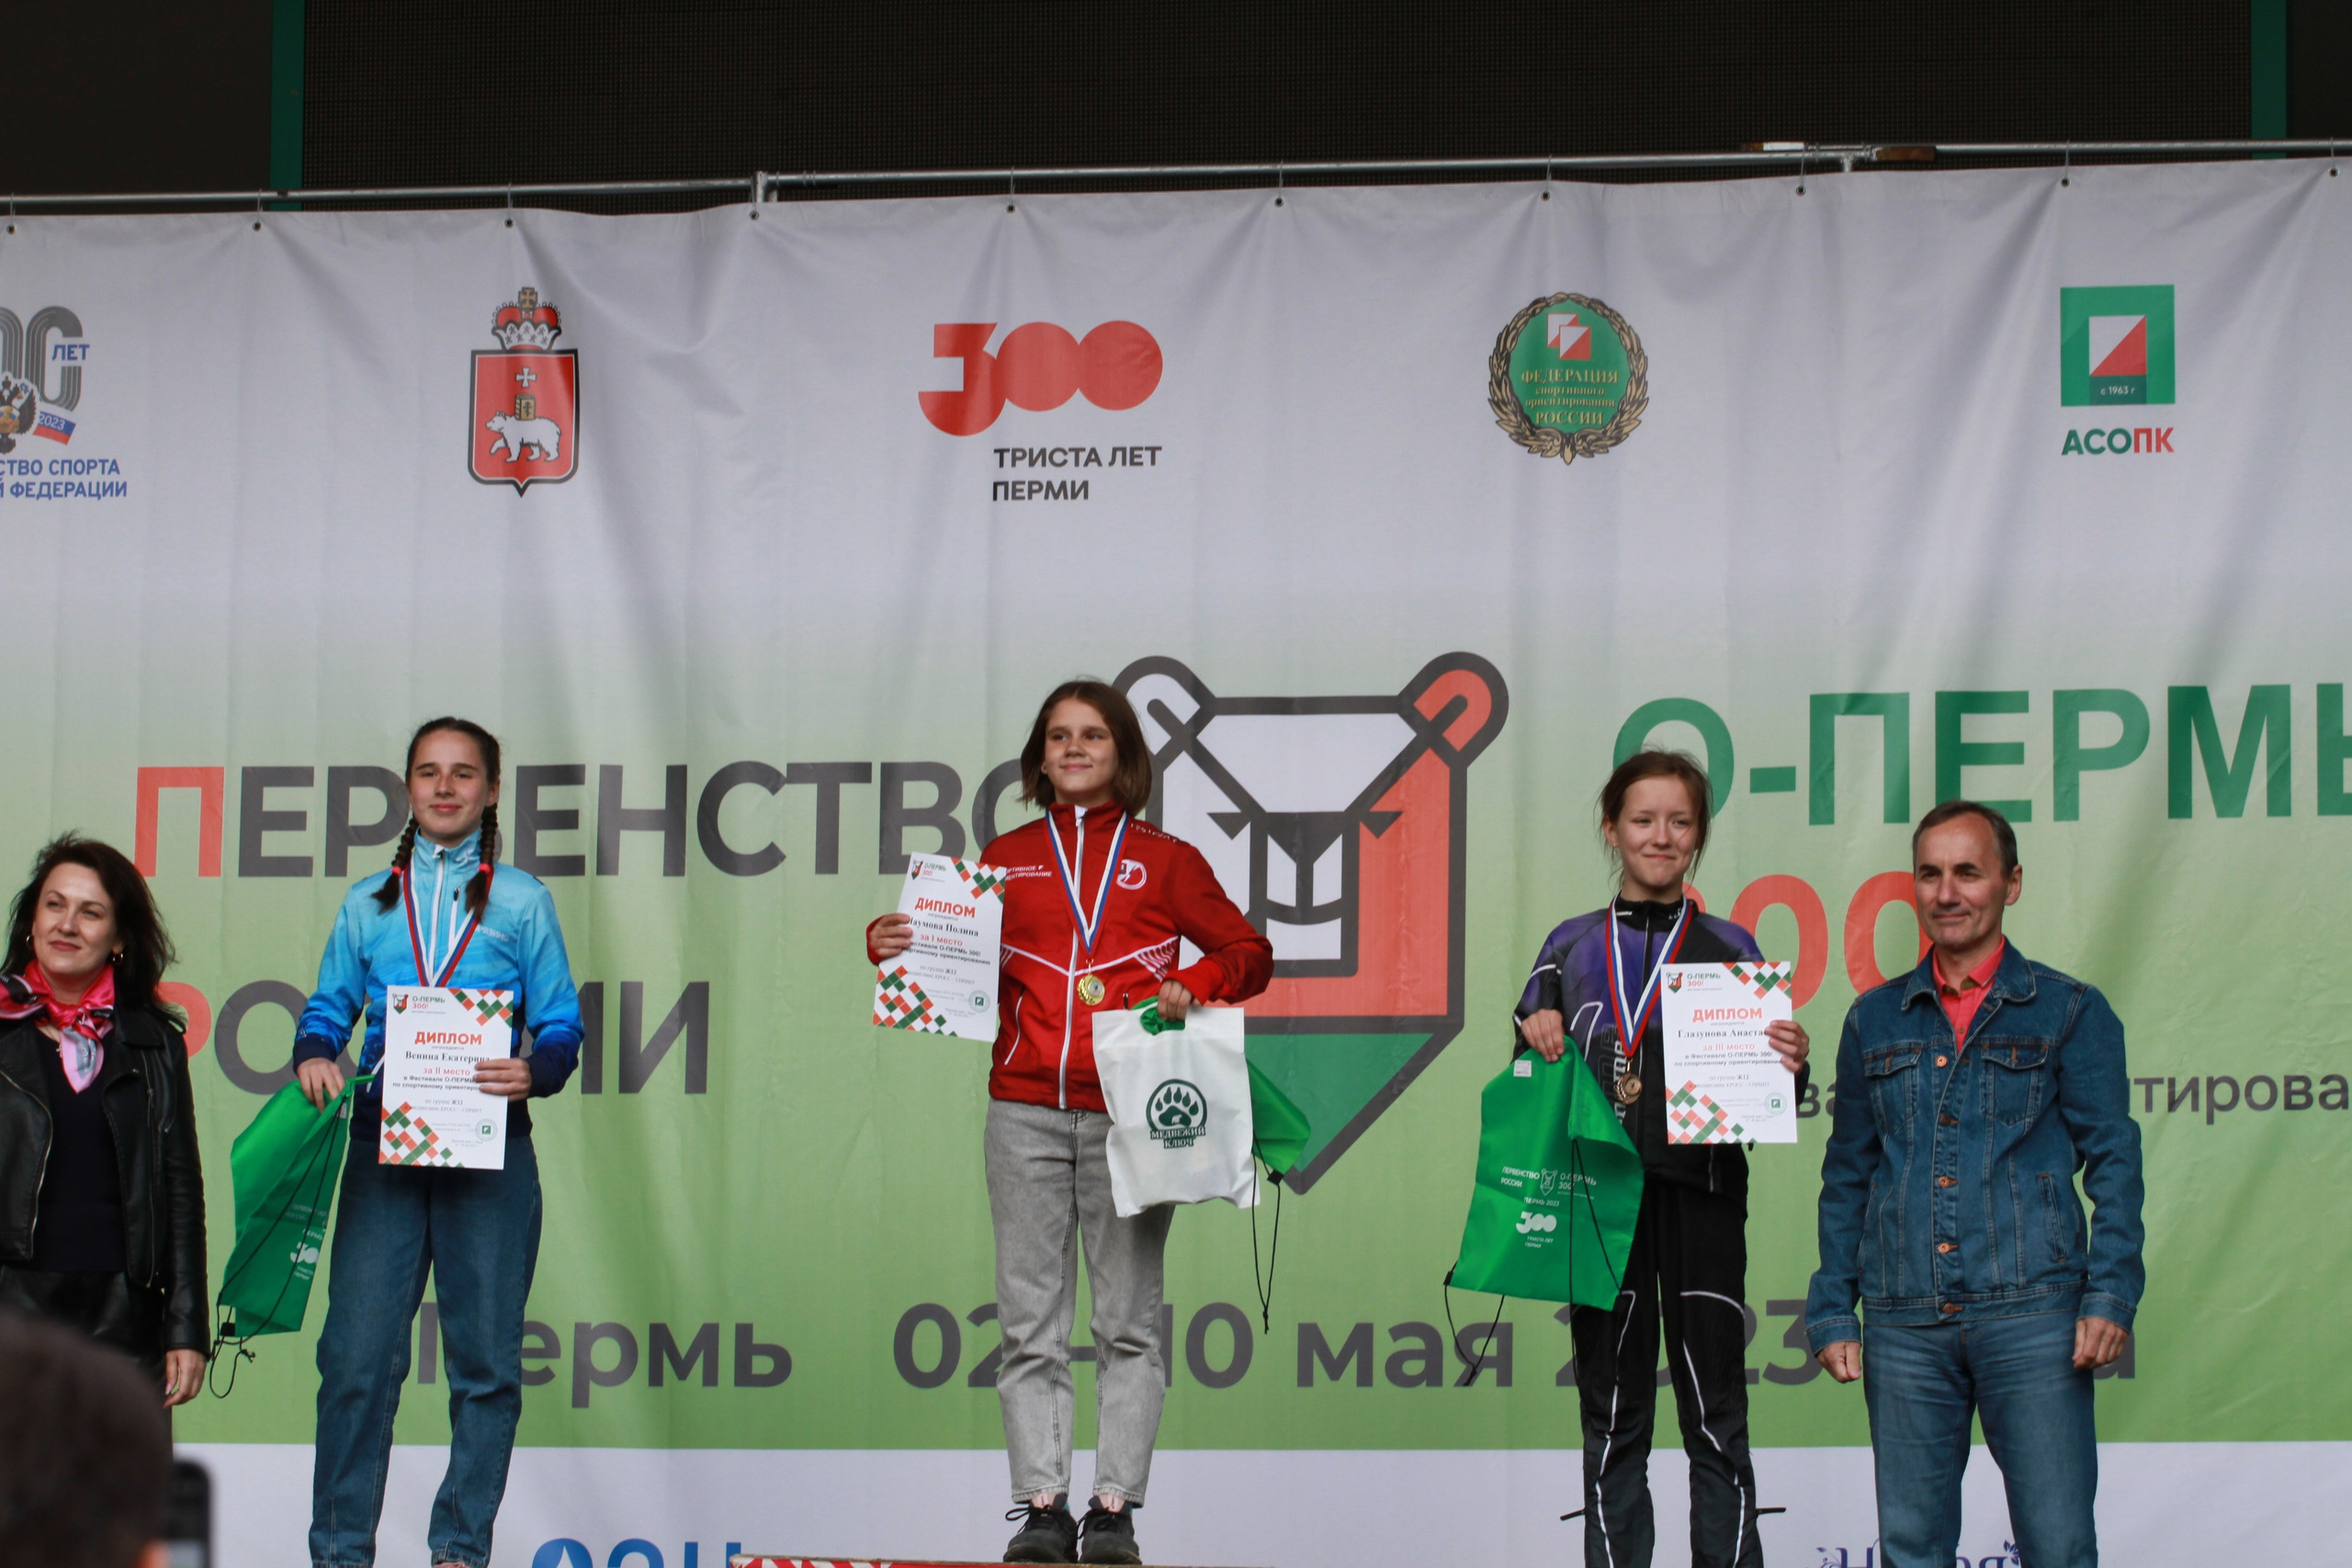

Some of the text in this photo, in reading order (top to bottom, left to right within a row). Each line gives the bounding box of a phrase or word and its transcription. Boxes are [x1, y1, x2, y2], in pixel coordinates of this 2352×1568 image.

[51, 344, 90, 362] ЛЕТ
[918, 320, 1163, 436] 300
[1521, 369, 1619, 385] ФЕДЕРАЦИЯ
[1535, 387, 1605, 396] спортивного
[2109, 386, 2129, 395] 1963
[1525, 398, 1615, 408] ориентирования
[39, 413, 65, 431] 2023
[1535, 412, 1603, 425] РОССИИ
[2061, 427, 2175, 456] АСОПК
[993, 446, 1163, 468] ТРИСТА ЛЕТ
[49, 458, 120, 476] СПОРТА
[10, 480, 128, 501] ФЕДЕРАЦИИ
[992, 480, 1090, 502] ПЕРМИ
[134, 761, 1022, 877] ПЕРЕНСТВ
[923, 863, 947, 872] О-ПЕРМЬ
[914, 897, 976, 918] ДИПЛОМ
[945, 923, 979, 937] Полина
[910, 942, 938, 951] естивале
[939, 945, 967, 955] О-ПЕРМЬ
[936, 937, 963, 947] место
[903, 948, 939, 958] ортивному
[1692, 1008, 1762, 1022] ДИПЛОМ
[414, 1031, 482, 1045] ДИПЛОМ
[1678, 1029, 1764, 1039] Глазунова Анаста
[2127, 1073, 2349, 1125] тирова
[1150, 1125, 1206, 1139] МЕДВЕЖИЙ
[1164, 1138, 1193, 1148] КЛЮЧ
[1501, 1166, 1541, 1179] ПЕРВЕНСТВО
[1500, 1177, 1523, 1188] РОССИИ
[1524, 1197, 1545, 1205] ПЕРМЬ
[1516, 1211, 1557, 1234] 300
[1296, 1319, 1514, 1389] мая
